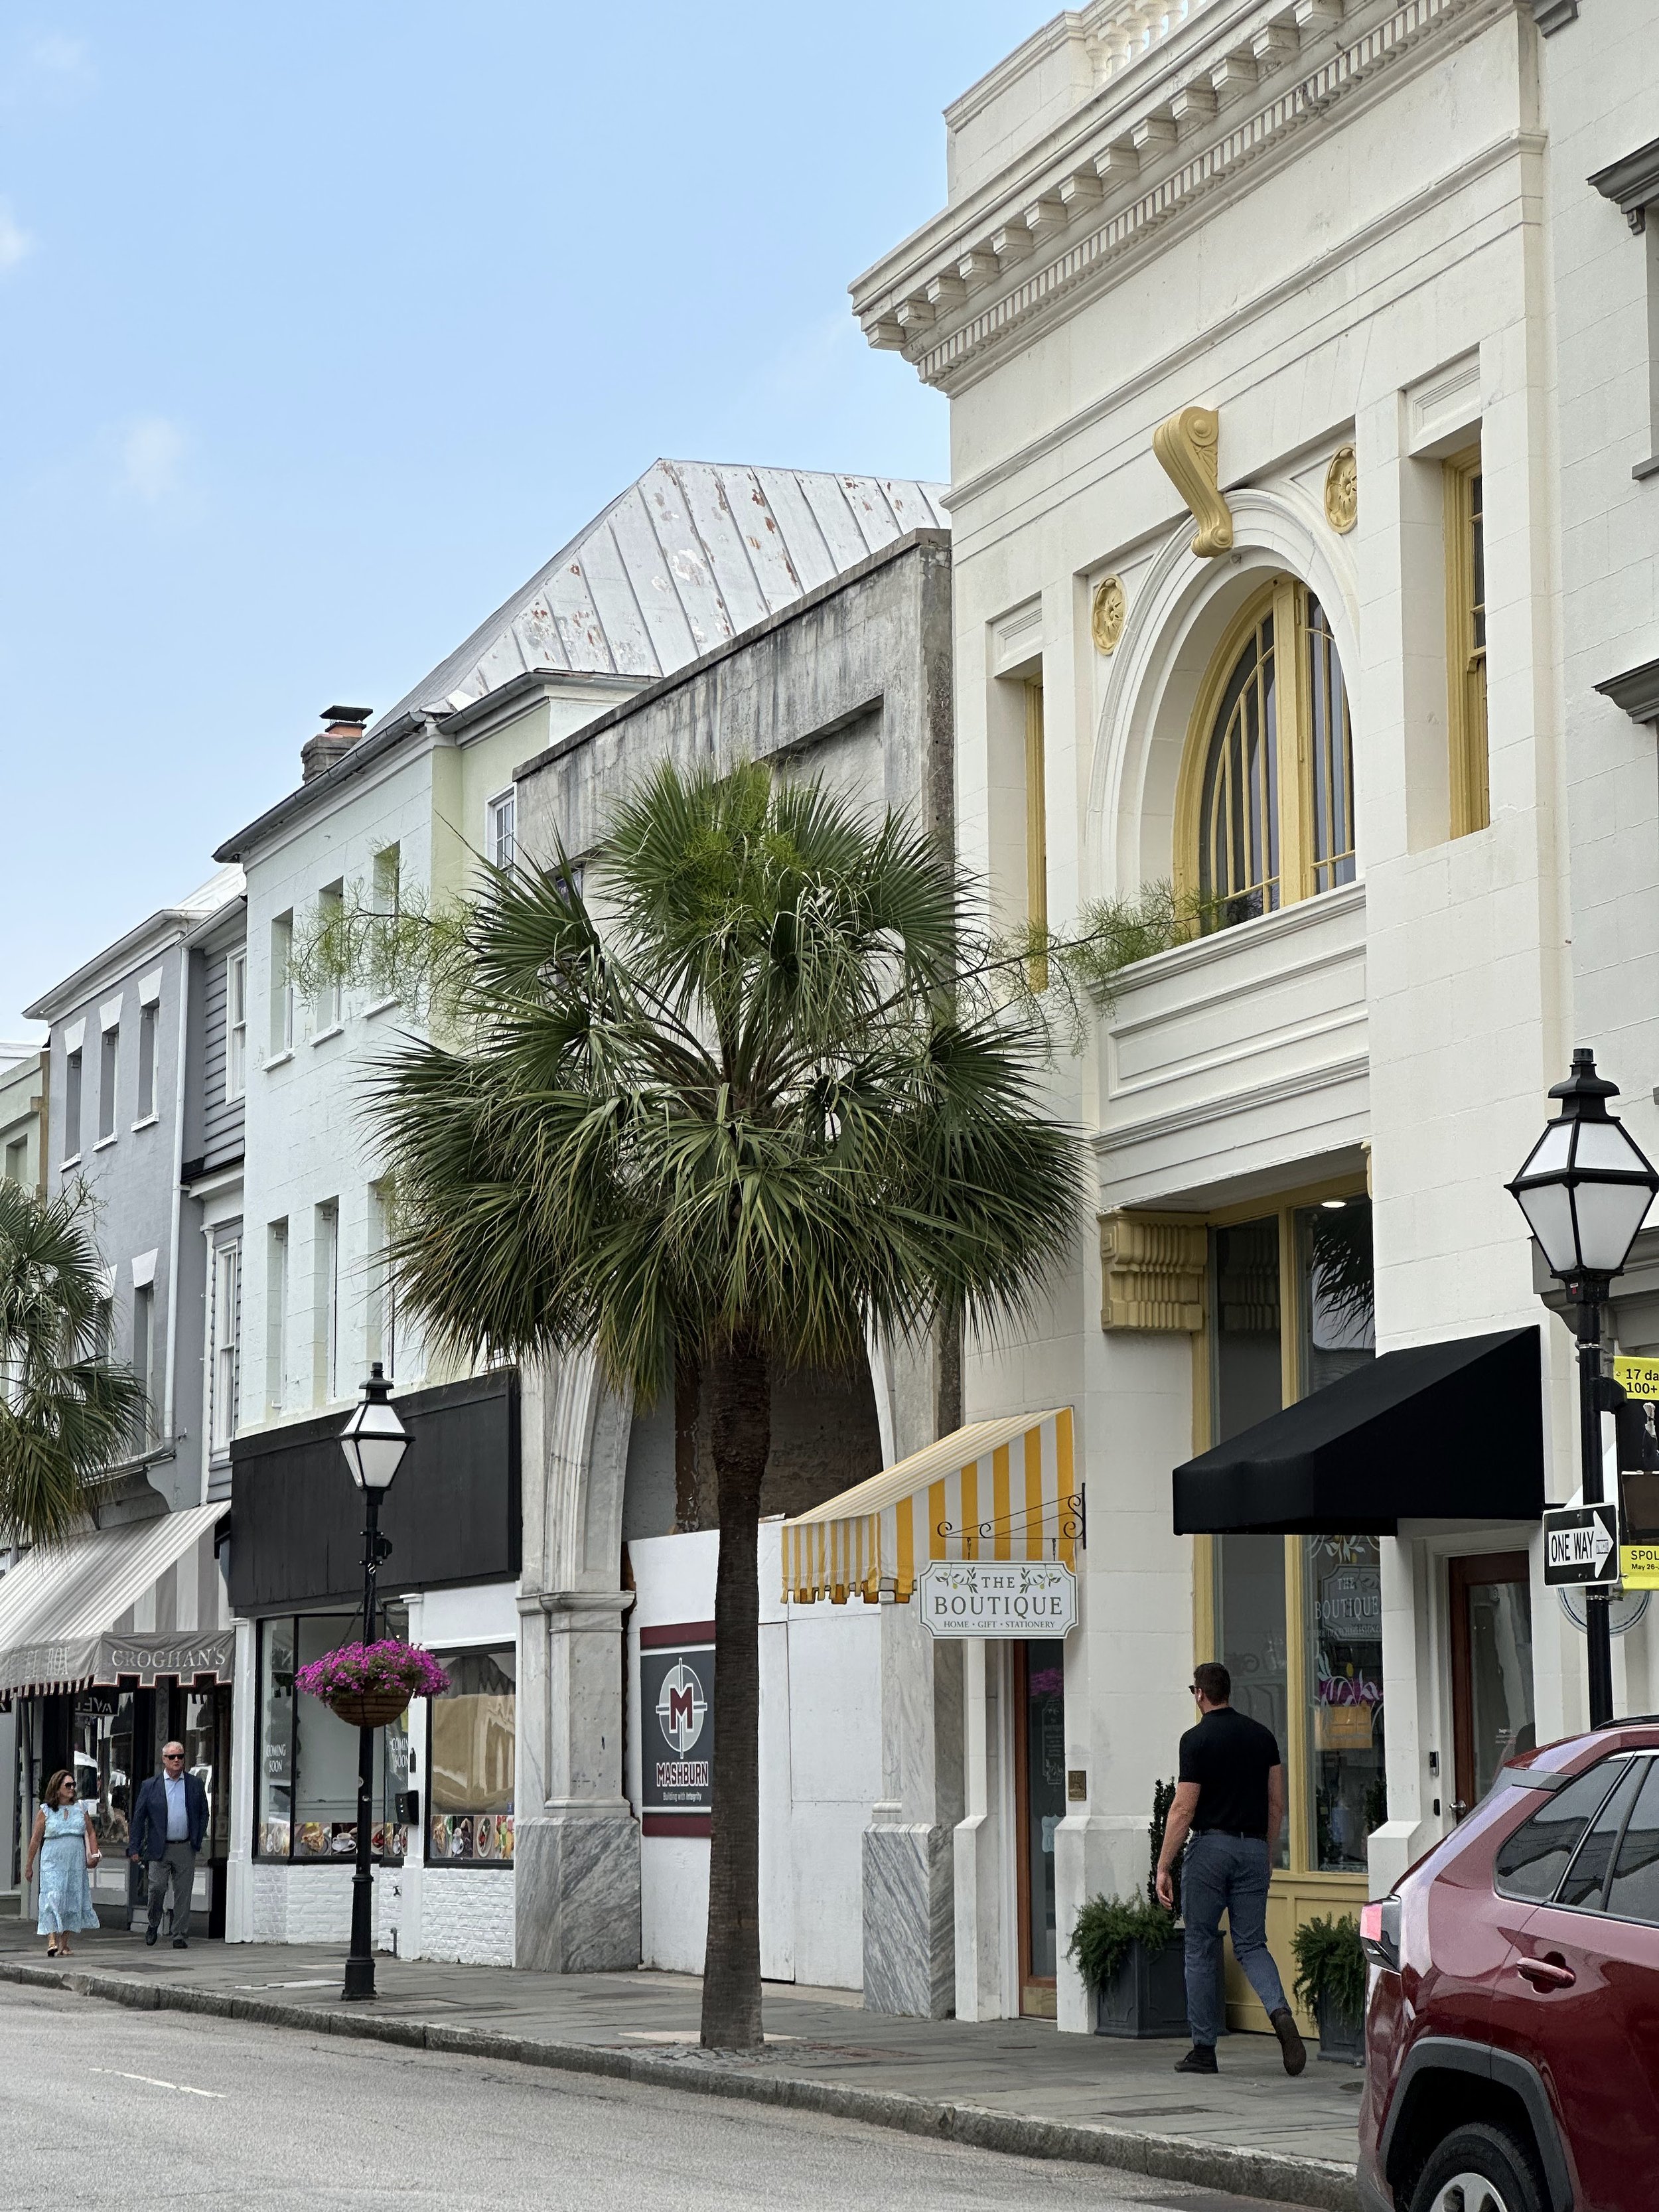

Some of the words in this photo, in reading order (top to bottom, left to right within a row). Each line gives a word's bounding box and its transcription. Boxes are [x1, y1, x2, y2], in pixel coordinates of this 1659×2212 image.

[1626, 1368, 1641, 1380] 17
[1626, 1382, 1658, 1394] 100+
[1551, 1533, 1571, 1563] ONE
[1573, 1530, 1595, 1560] WAY
[1631, 1563, 1646, 1572] May
[981, 1576, 1015, 1588] THE
[1337, 1577, 1354, 1590] THE
[934, 1596, 1062, 1619] BOUTIQUE
[1315, 1595, 1379, 1621] BOUTIQUE
[46, 1647, 70, 1676] BOX
[111, 1647, 226, 1668] CROGHAN'S
[668, 1682, 694, 1734] M
[266, 1744, 287, 1757] COMING
[269, 1759, 283, 1773] SOON
[656, 1761, 709, 1787] MASHBURN
